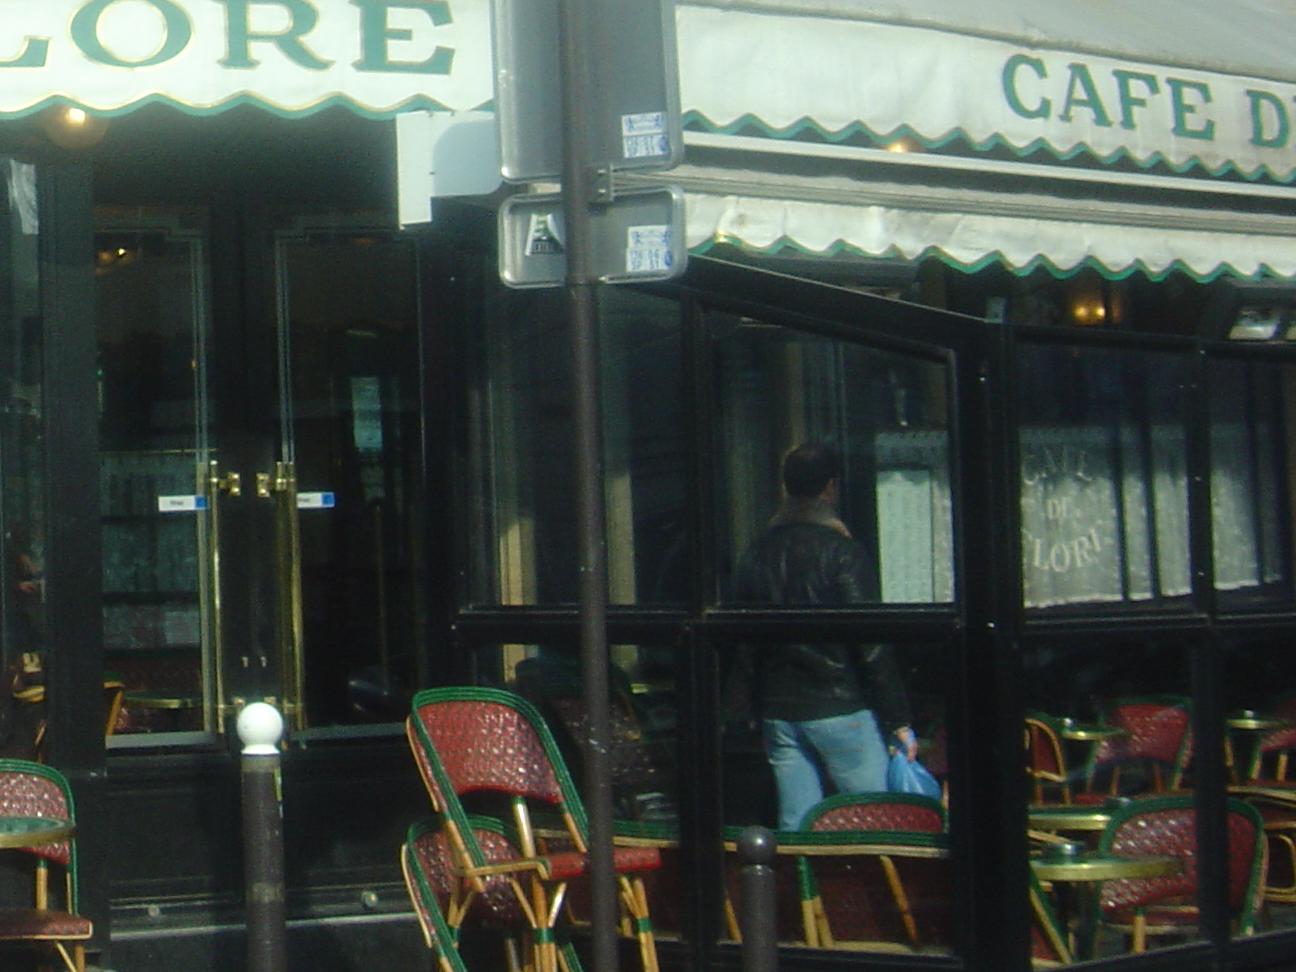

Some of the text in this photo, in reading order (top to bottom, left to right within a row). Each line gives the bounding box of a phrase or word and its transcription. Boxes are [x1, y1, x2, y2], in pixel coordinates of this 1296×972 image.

[1001, 52, 1296, 149] CAFE D
[1023, 523, 1107, 573] LOR
